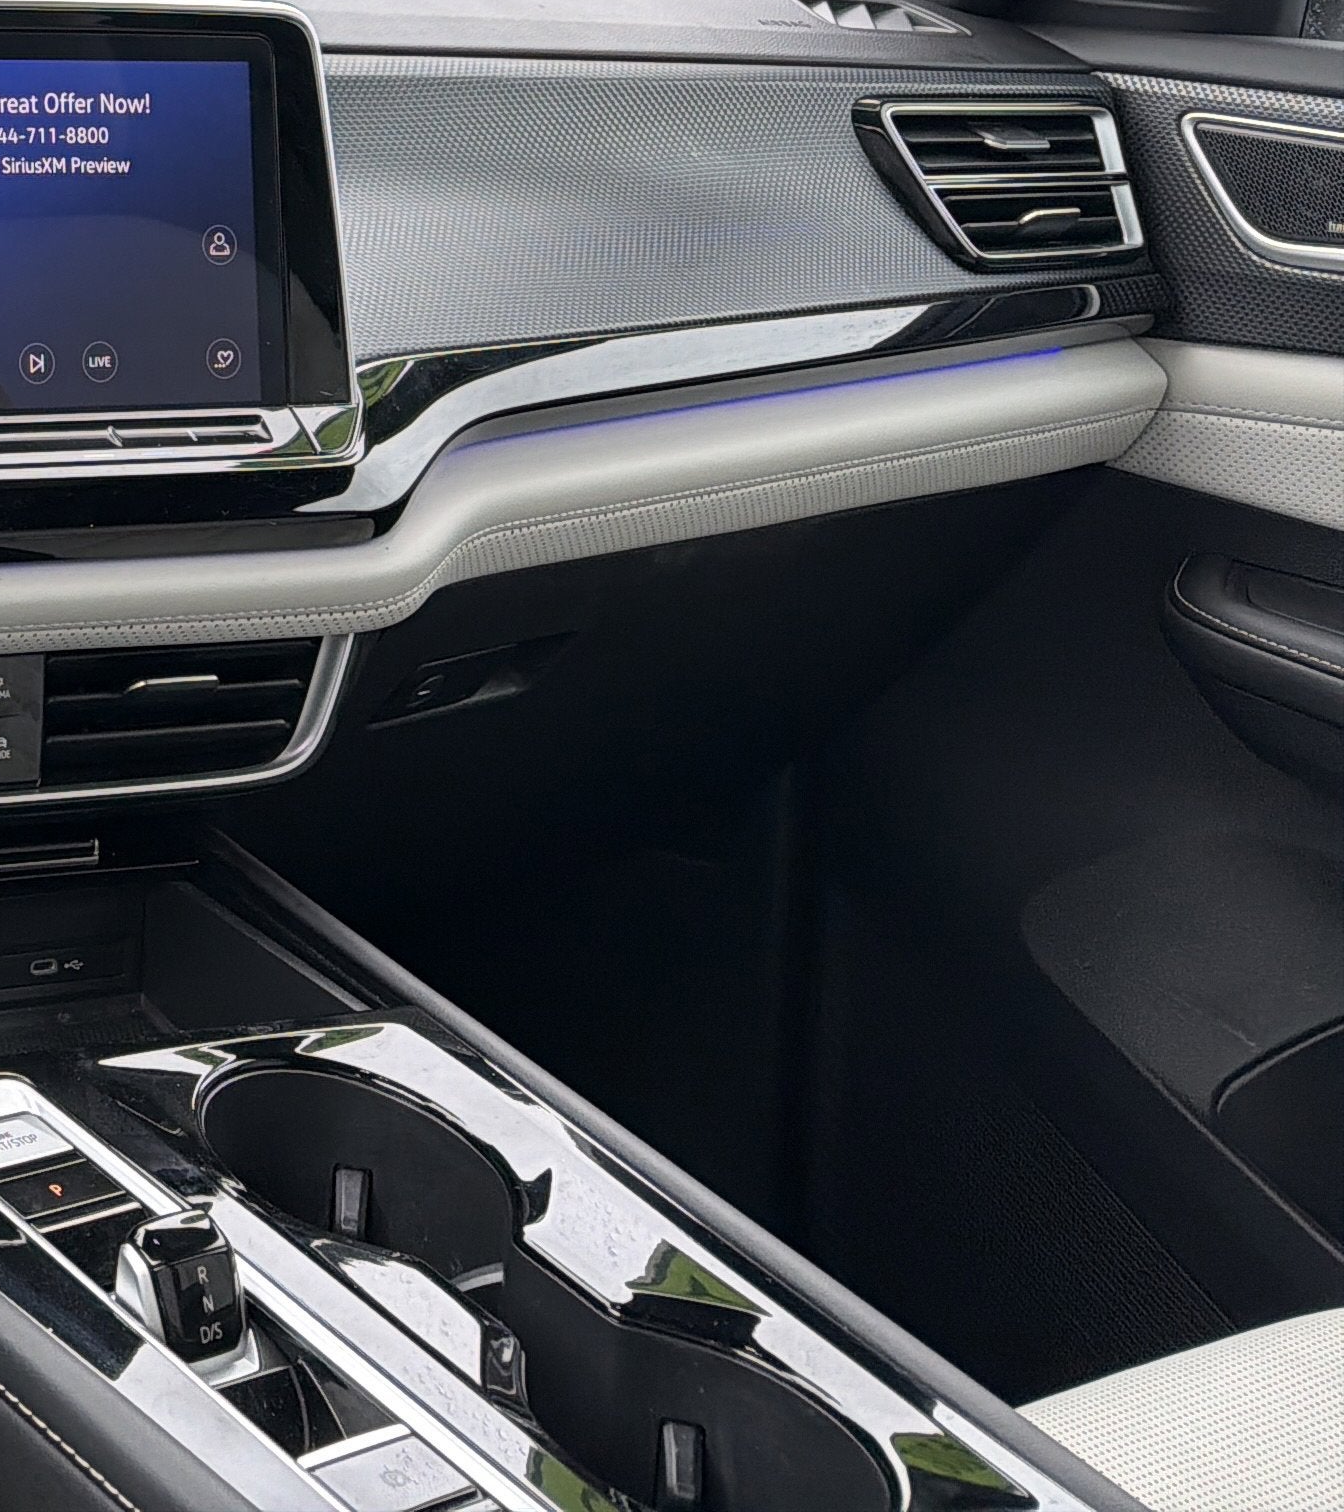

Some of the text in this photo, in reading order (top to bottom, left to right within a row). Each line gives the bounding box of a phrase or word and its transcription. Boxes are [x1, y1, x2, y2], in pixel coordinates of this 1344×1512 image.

[44, 92, 94, 114] Offer
[99, 92, 151, 115] Now!
[1, 156, 67, 174] SiriusXM
[71, 156, 131, 174] Preview
[88, 355, 112, 368] LIVE
[197, 1266, 209, 1285] R
[202, 1294, 214, 1313] N
[199, 1321, 223, 1344] D/S
